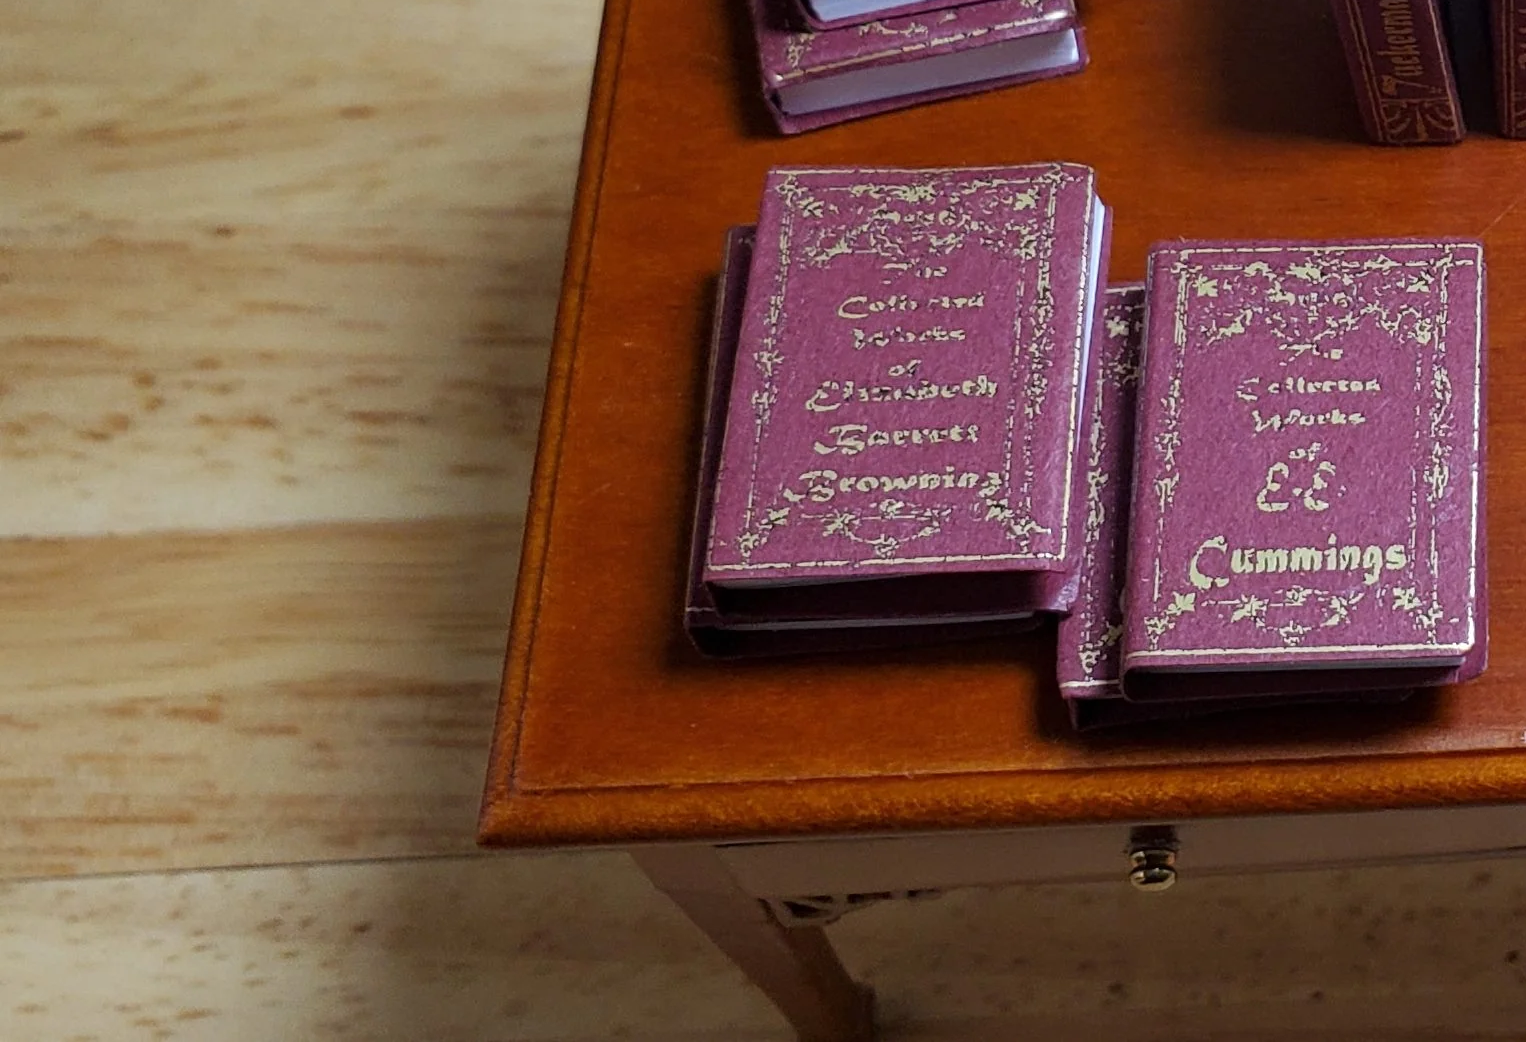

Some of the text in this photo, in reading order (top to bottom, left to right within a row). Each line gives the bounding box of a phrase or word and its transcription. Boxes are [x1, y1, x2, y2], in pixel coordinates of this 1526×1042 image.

[889, 360, 921, 376] of
[1252, 409, 1365, 432] Works
[1289, 442, 1321, 461] of
[1189, 533, 1408, 589] Cummings
